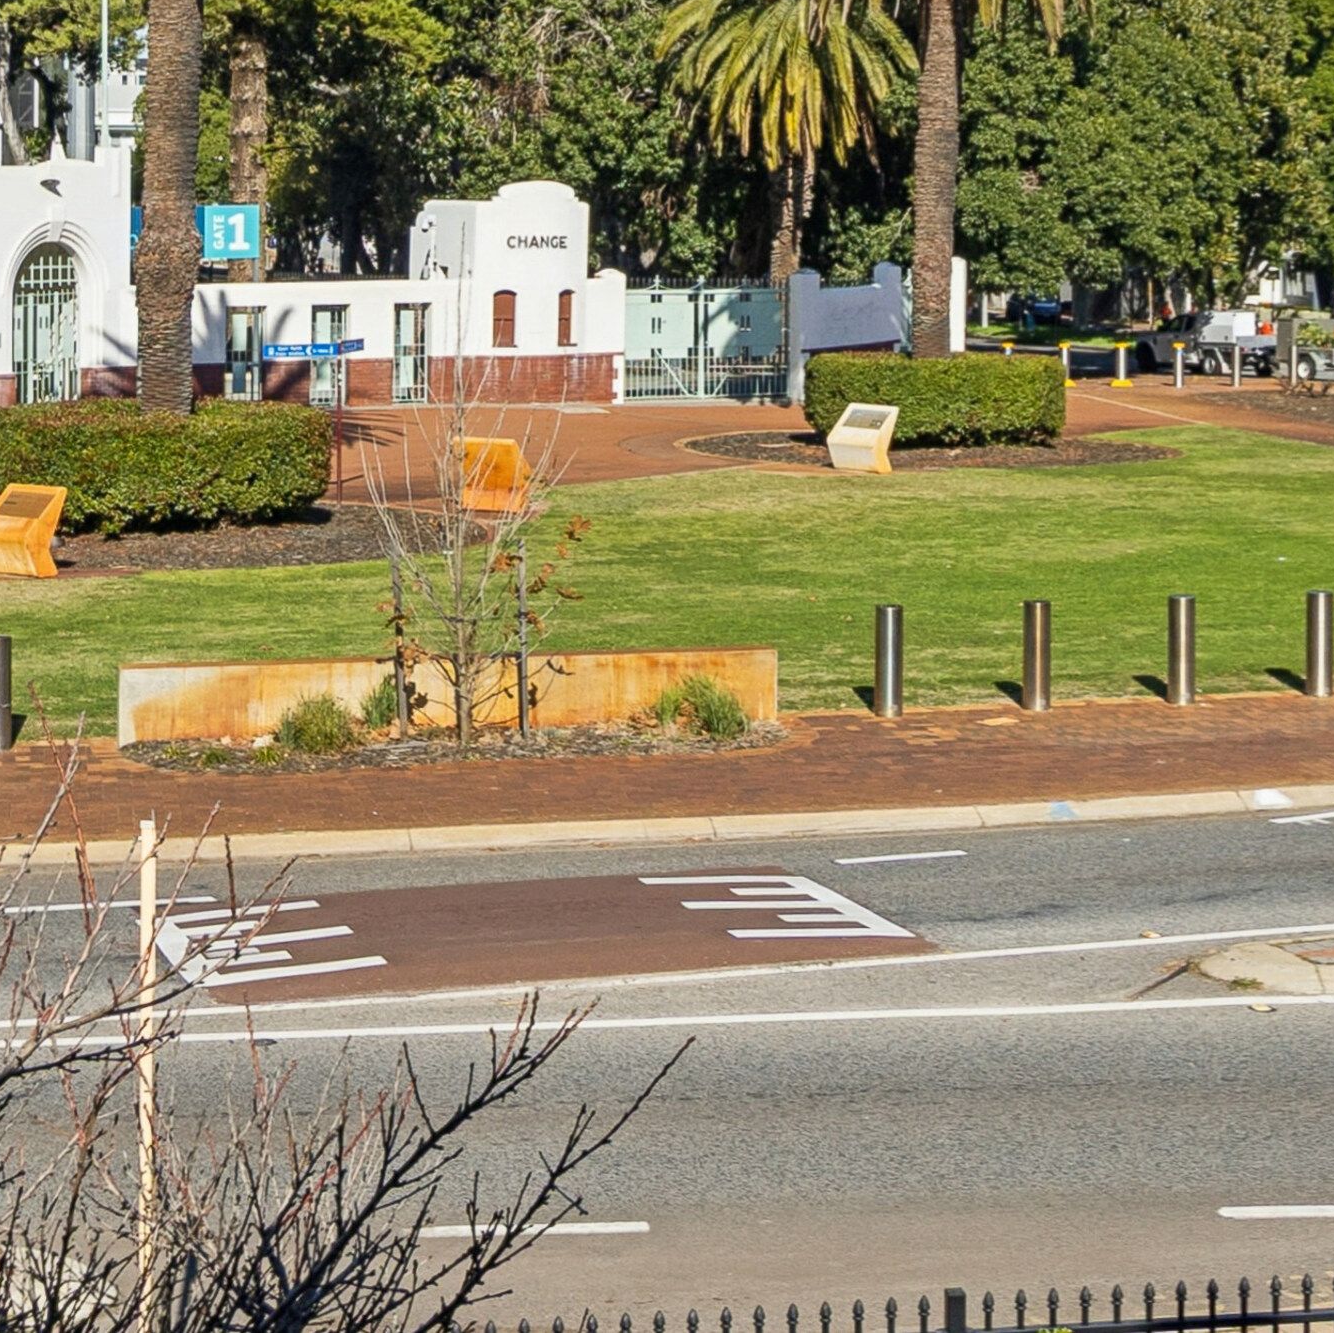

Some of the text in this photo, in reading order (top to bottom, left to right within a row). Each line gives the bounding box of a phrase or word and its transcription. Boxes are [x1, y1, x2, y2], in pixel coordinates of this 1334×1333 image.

[212, 213, 250, 251] GATE 1
[506, 235, 568, 249] CHANGE
